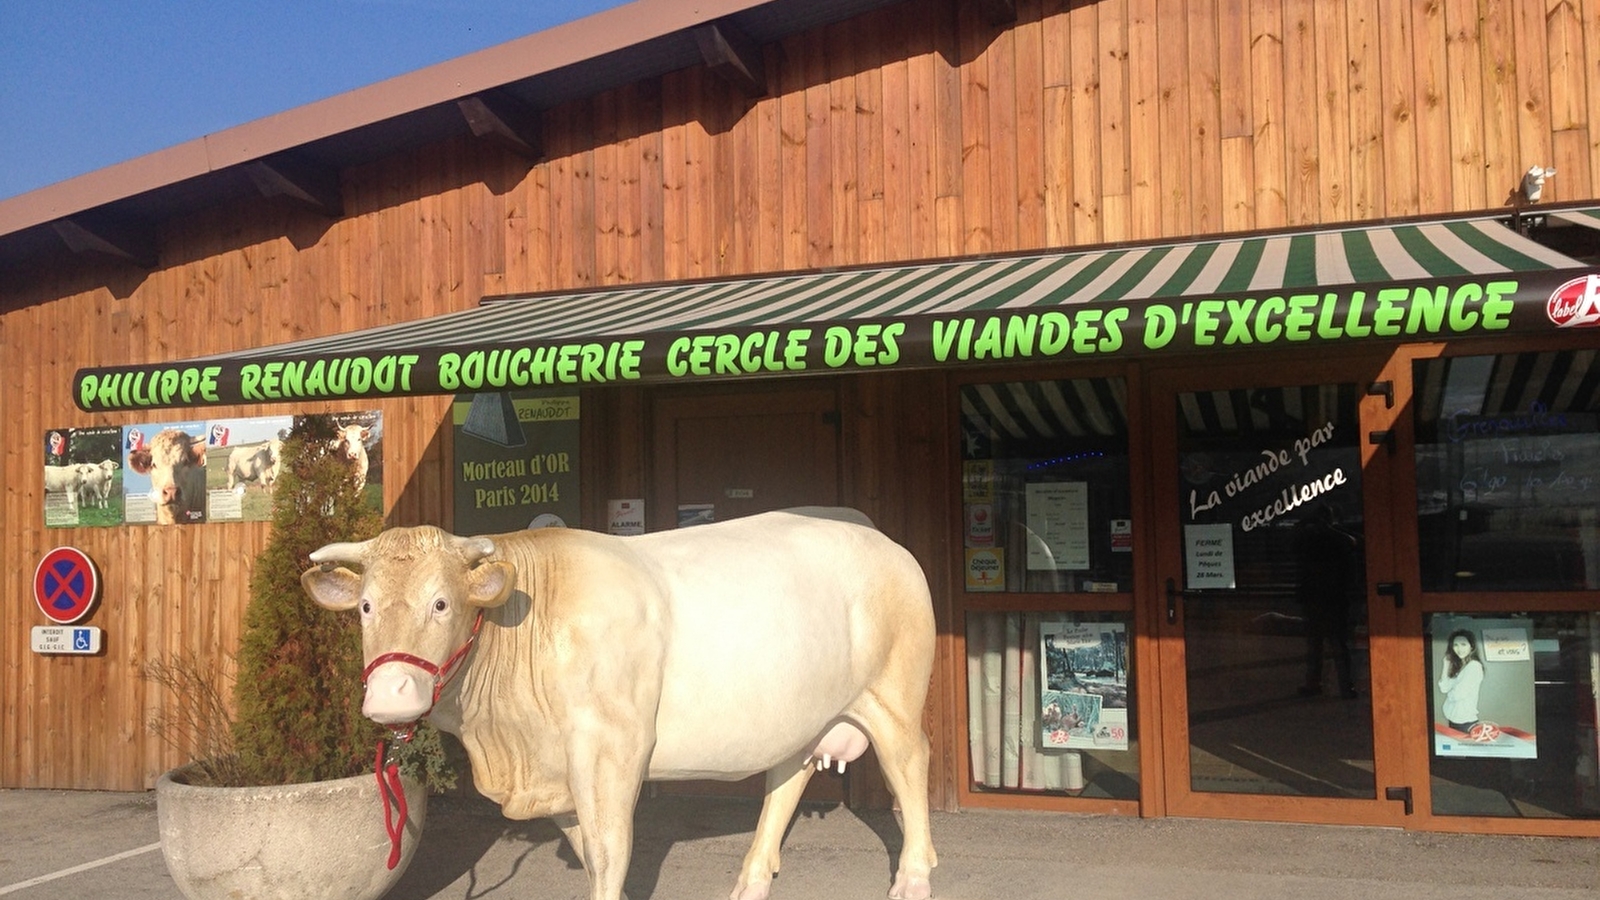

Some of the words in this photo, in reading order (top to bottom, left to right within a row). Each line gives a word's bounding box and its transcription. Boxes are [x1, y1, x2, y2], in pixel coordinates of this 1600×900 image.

[81, 367, 221, 408] PHILIPPE
[241, 354, 418, 399] RENAUDOT
[439, 340, 644, 389] BOUCHERIE
[667, 329, 811, 376] CERCLE
[824, 322, 905, 367] DES
[932, 307, 1128, 361] VIANDES
[1143, 281, 1518, 348] D'EXCELLENCE
[463, 459, 525, 482] Morteau
[530, 452, 571, 475] d'OR
[475, 485, 516, 509] Paris
[520, 482, 560, 505] 2014
[1190, 489, 1222, 520] La
[1225, 450, 1293, 498] viande
[1294, 422, 1335, 466] par
[1241, 467, 1348, 532] excellence
